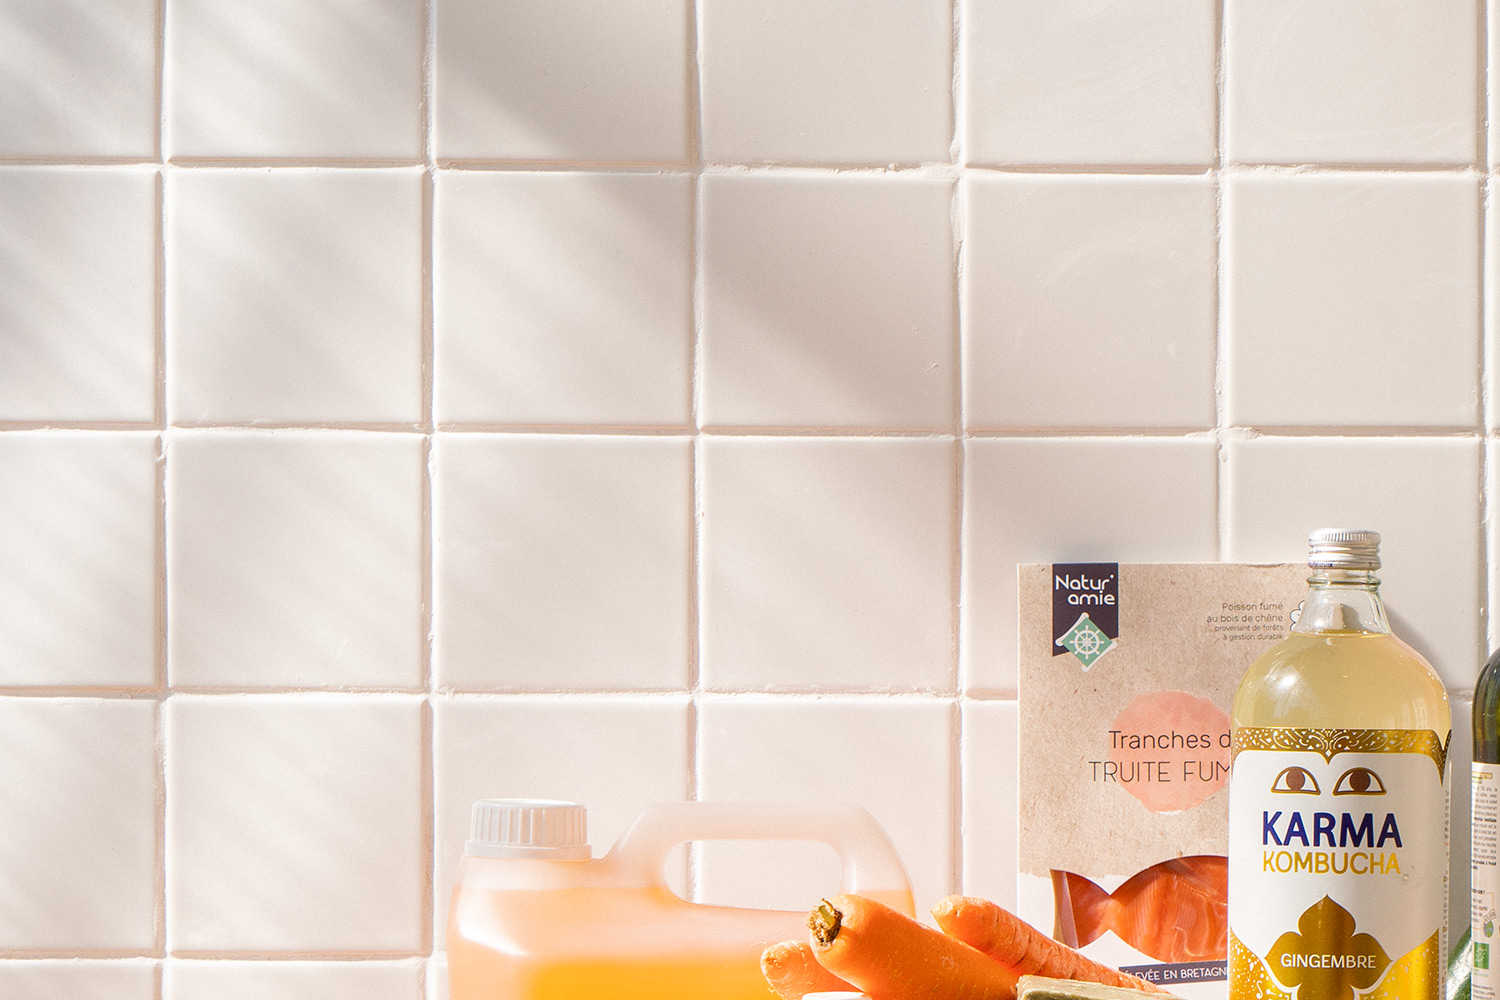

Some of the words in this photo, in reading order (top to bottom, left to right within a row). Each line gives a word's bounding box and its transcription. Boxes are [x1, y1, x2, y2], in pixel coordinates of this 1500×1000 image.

[1055, 574, 1114, 591] Natur'
[1067, 590, 1115, 605] amie
[1222, 602, 1257, 611] Poisson
[1259, 602, 1283, 611] fumé
[1206, 615, 1218, 623] au
[1220, 614, 1239, 623] bois
[1241, 614, 1253, 623] de
[1254, 613, 1284, 622] chêne
[1229, 633, 1255, 642] gestion
[1108, 730, 1211, 749] Tranches
[1088, 760, 1171, 783] TRUITE
[1183, 760, 1231, 783] FUM
[1262, 811, 1402, 848] KARMA
[1262, 850, 1401, 875] KOMBUCHA
[1280, 953, 1377, 969] GINGEMBRE
[1163, 969, 1178, 980] EN
[1180, 966, 1227, 980] BRETAGN
